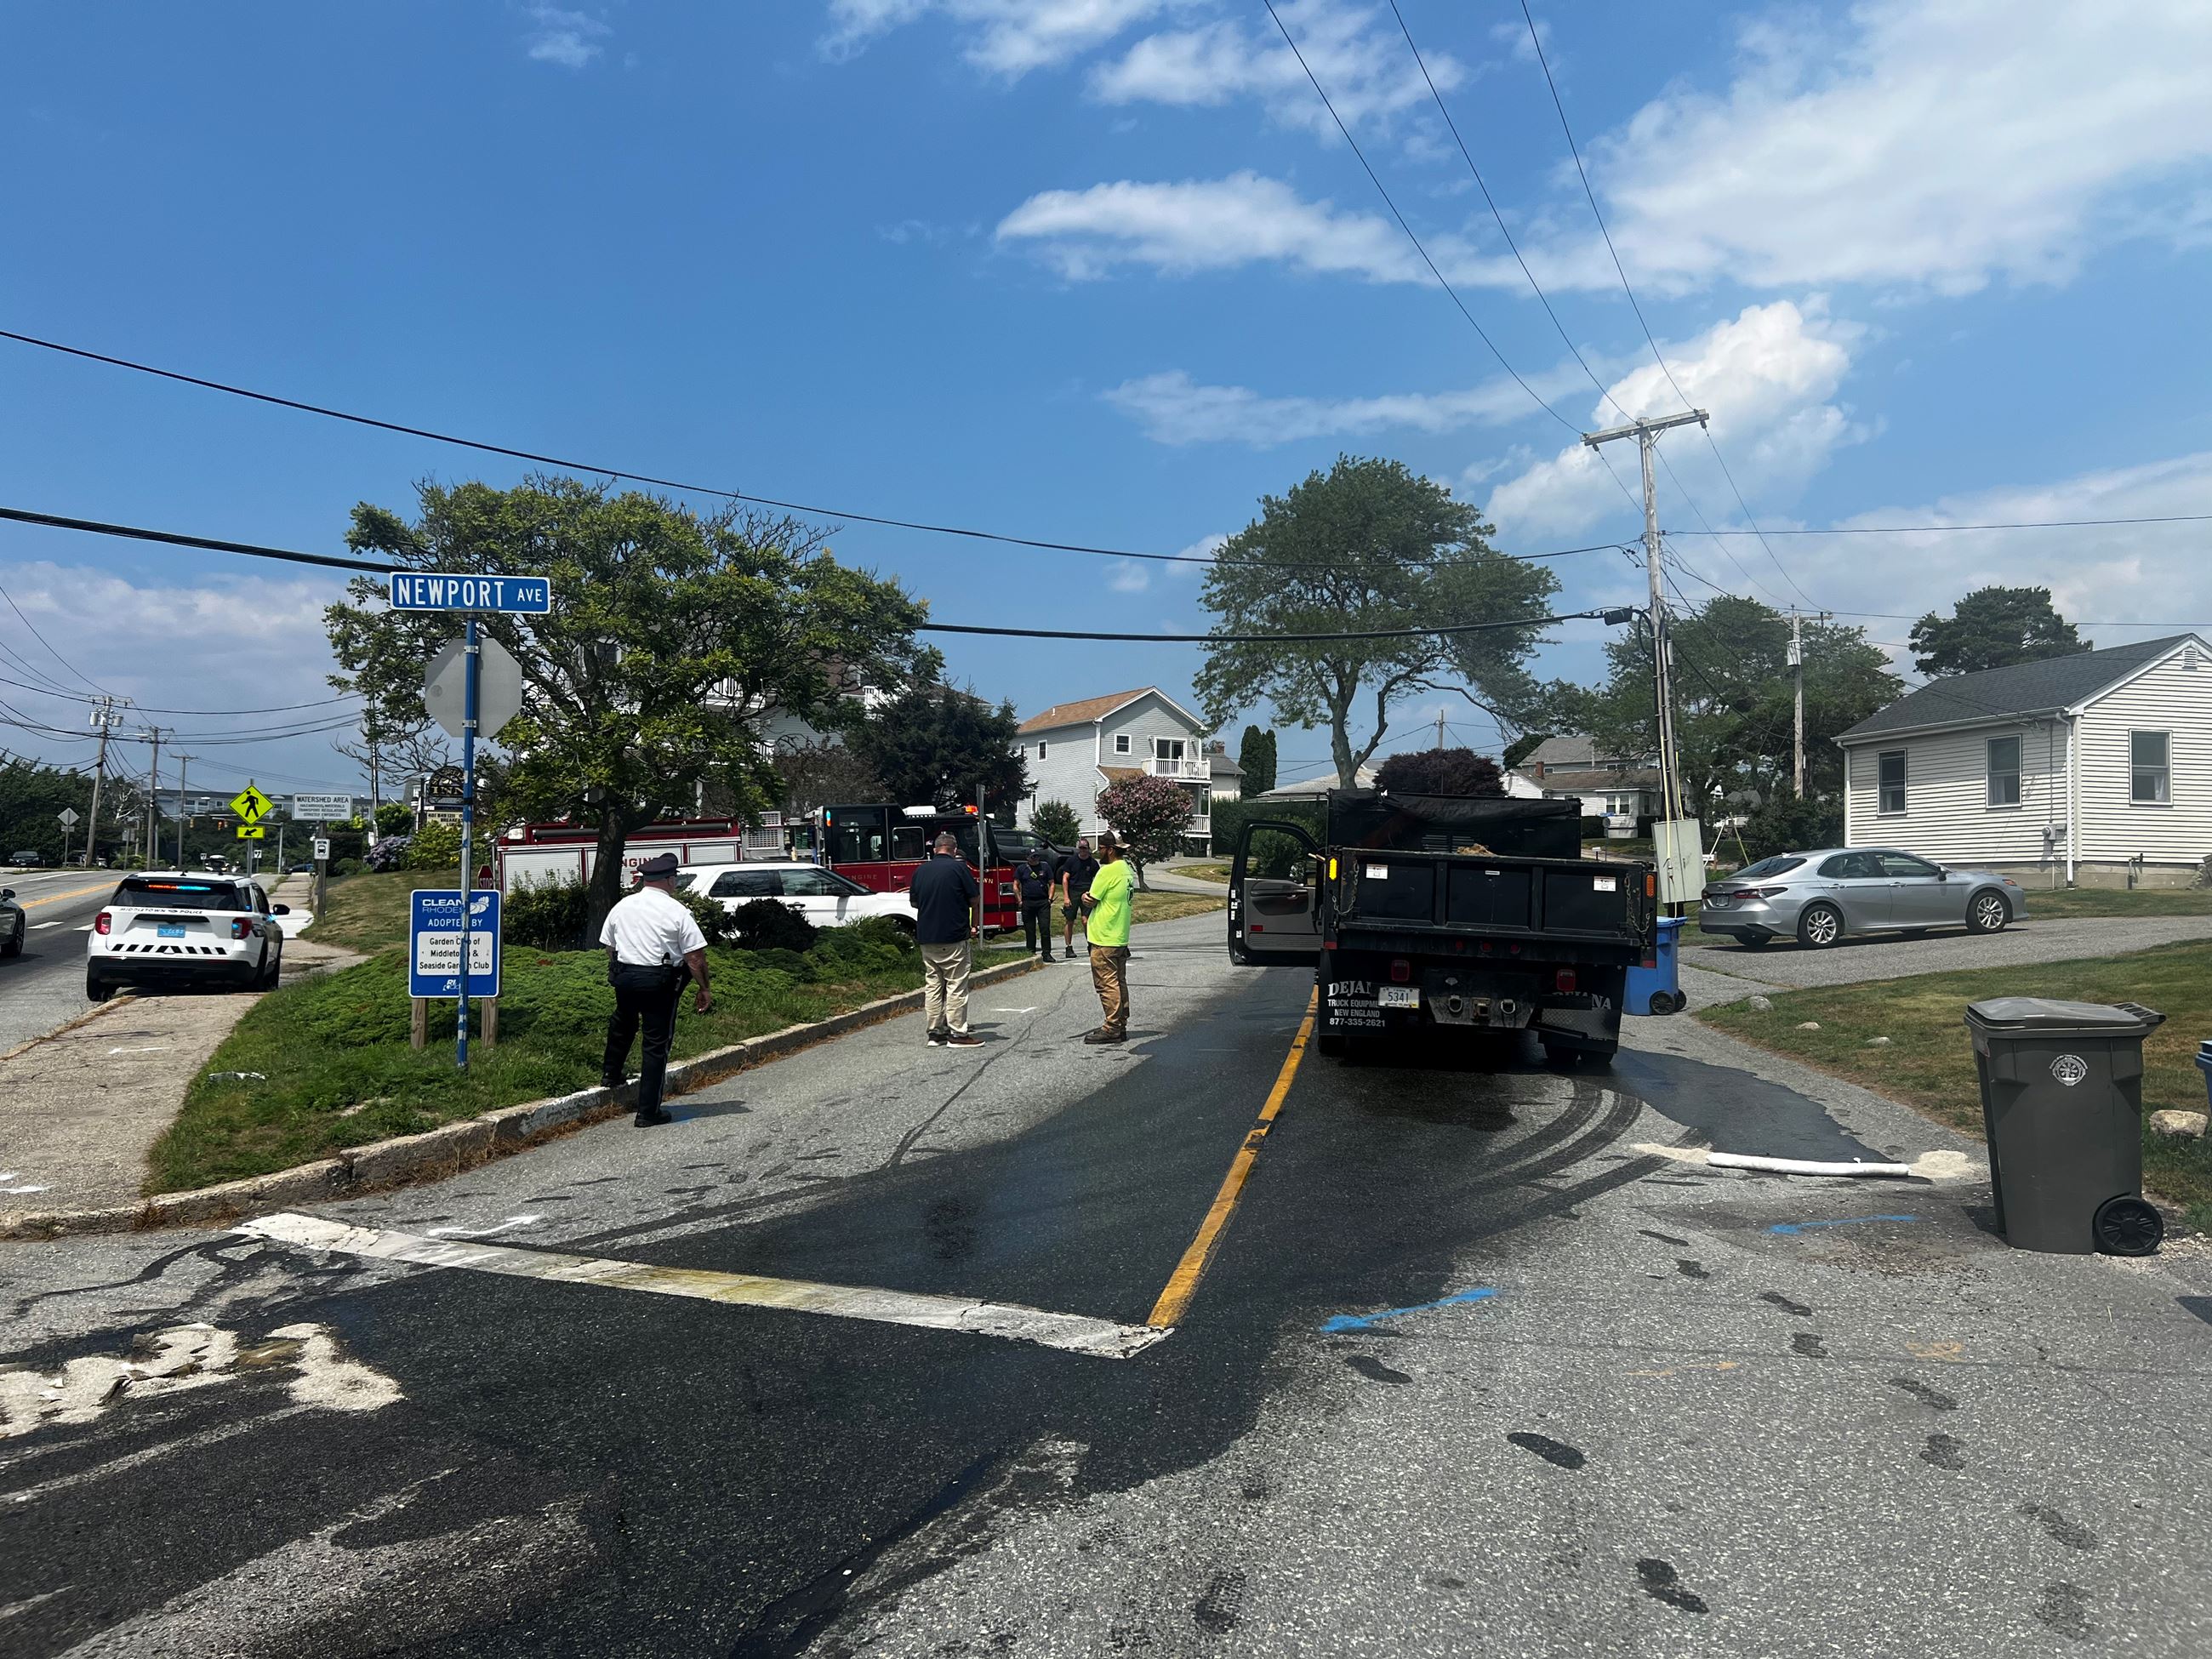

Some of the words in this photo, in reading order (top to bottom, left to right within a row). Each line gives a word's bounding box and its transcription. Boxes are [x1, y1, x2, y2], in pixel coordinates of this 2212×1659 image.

[398, 579, 505, 607] NEWPORT
[516, 588, 543, 602] AVE
[427, 918, 461, 926] ADOPTE
[471, 918, 483, 926] BY
[1388, 991, 1409, 1003] 5341
[1327, 999, 1349, 1007] TRUCK
[1334, 1008, 1349, 1017] NEW
[1350, 1009, 1380, 1018] ENGLAND
[1329, 1018, 1386, 1027] 877-335-2621
